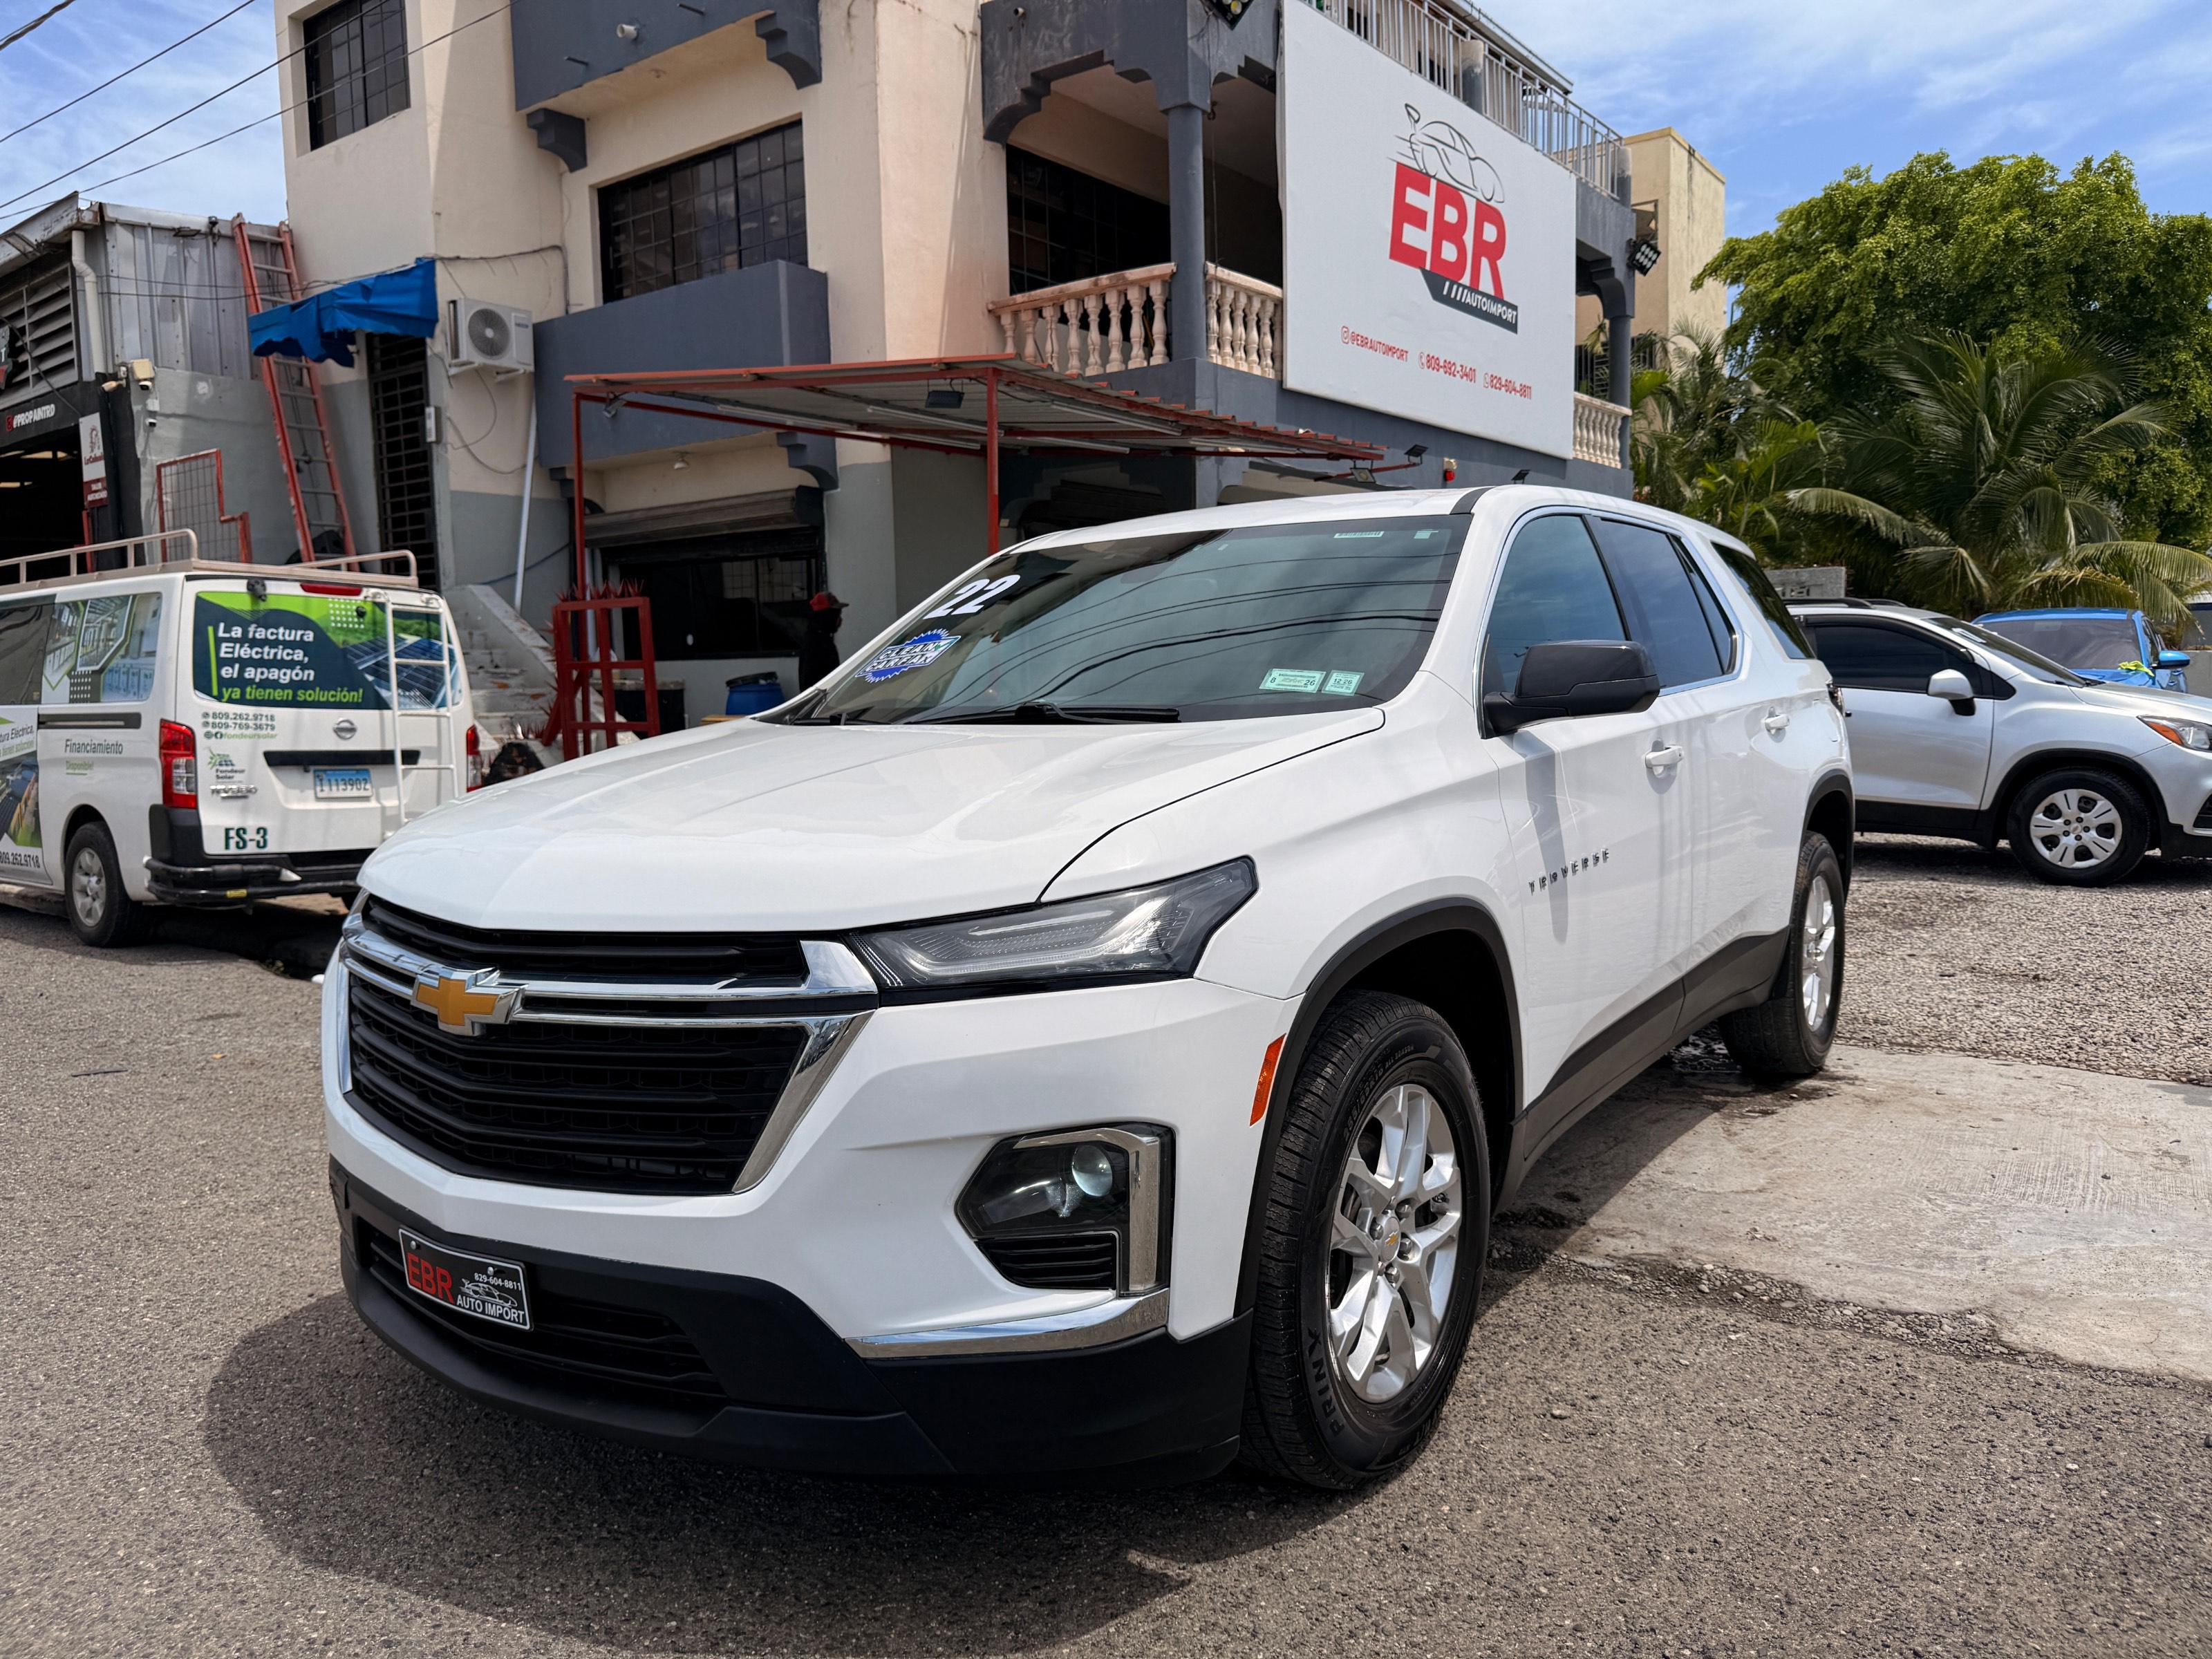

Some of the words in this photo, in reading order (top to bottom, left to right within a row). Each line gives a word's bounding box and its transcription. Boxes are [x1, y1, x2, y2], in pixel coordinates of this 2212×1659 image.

[1389, 162, 1506, 300] EBR
[1465, 291, 1517, 324] AUTOIMPORT
[1350, 331, 1409, 362] @EBRAUTOIMPORT
[1425, 354, 1477, 383] 809-692-3401
[1489, 374, 1533, 400] 829-604-8811
[923, 574, 1021, 620] 22
[218, 622, 242, 638] La
[247, 624, 315, 642] factura
[219, 642, 310, 664] Eléctrica,
[879, 641, 939, 659] CLEAN
[865, 653, 935, 672] CARFAX
[220, 664, 240, 679] el
[244, 665, 315, 684] apagón
[221, 686, 241, 703] ya
[245, 685, 293, 701] tienen
[297, 686, 364, 703] solución!
[211, 721, 276, 731] 809-769-3679
[212, 712, 276, 722] 809.262.9718
[64, 738, 124, 755] Financiamiento
[225, 827, 268, 850] FS-3
[1528, 849, 1609, 896] TRAVERSE
[407, 1252, 455, 1305] EBR
[474, 1273, 521, 1291] 829-604-8811
[457, 1294, 483, 1312] AUTO
[485, 1302, 525, 1323] IMPORT
